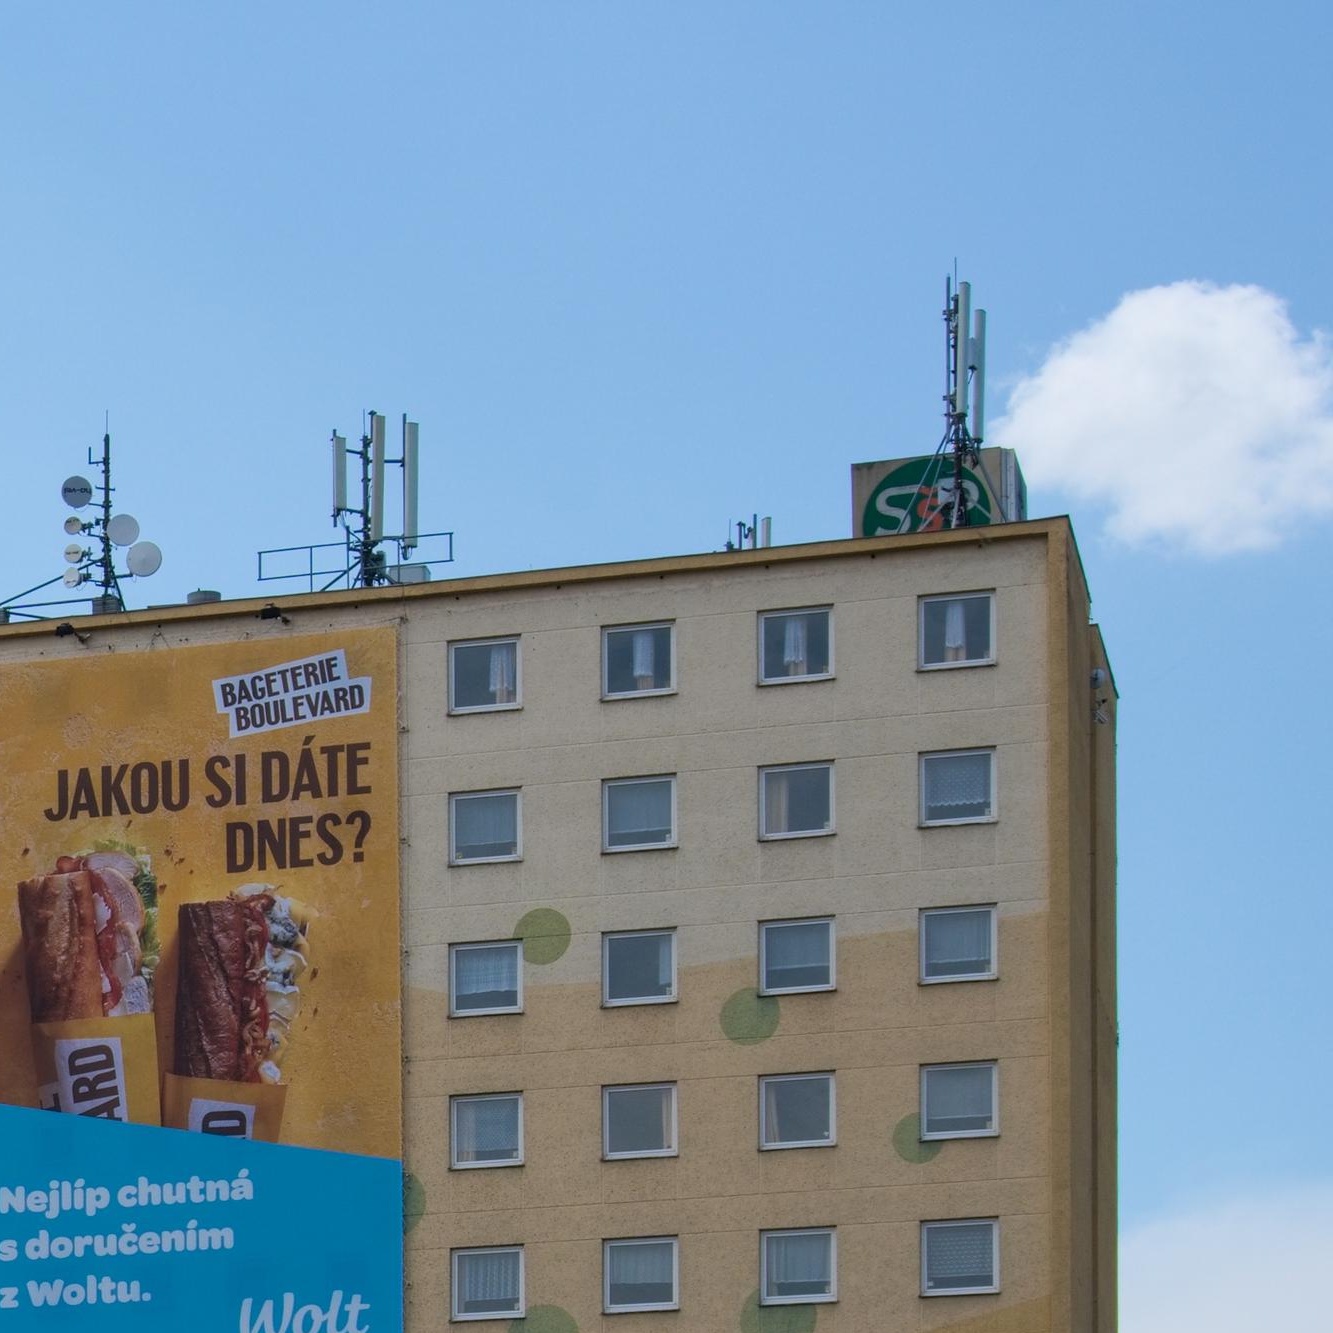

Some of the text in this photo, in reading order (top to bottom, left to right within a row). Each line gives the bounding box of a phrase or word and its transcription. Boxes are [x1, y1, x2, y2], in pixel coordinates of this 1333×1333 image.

[220, 655, 341, 708] BAGETERIE
[235, 683, 365, 732] BOULEVARD
[43, 735, 372, 822] JAKOU SI DÁTE
[225, 809, 372, 873] DNES?
[117, 1168, 254, 1207] chutná
[25, 1218, 234, 1261] doručením
[0, 1275, 152, 1309] z Woltu.
